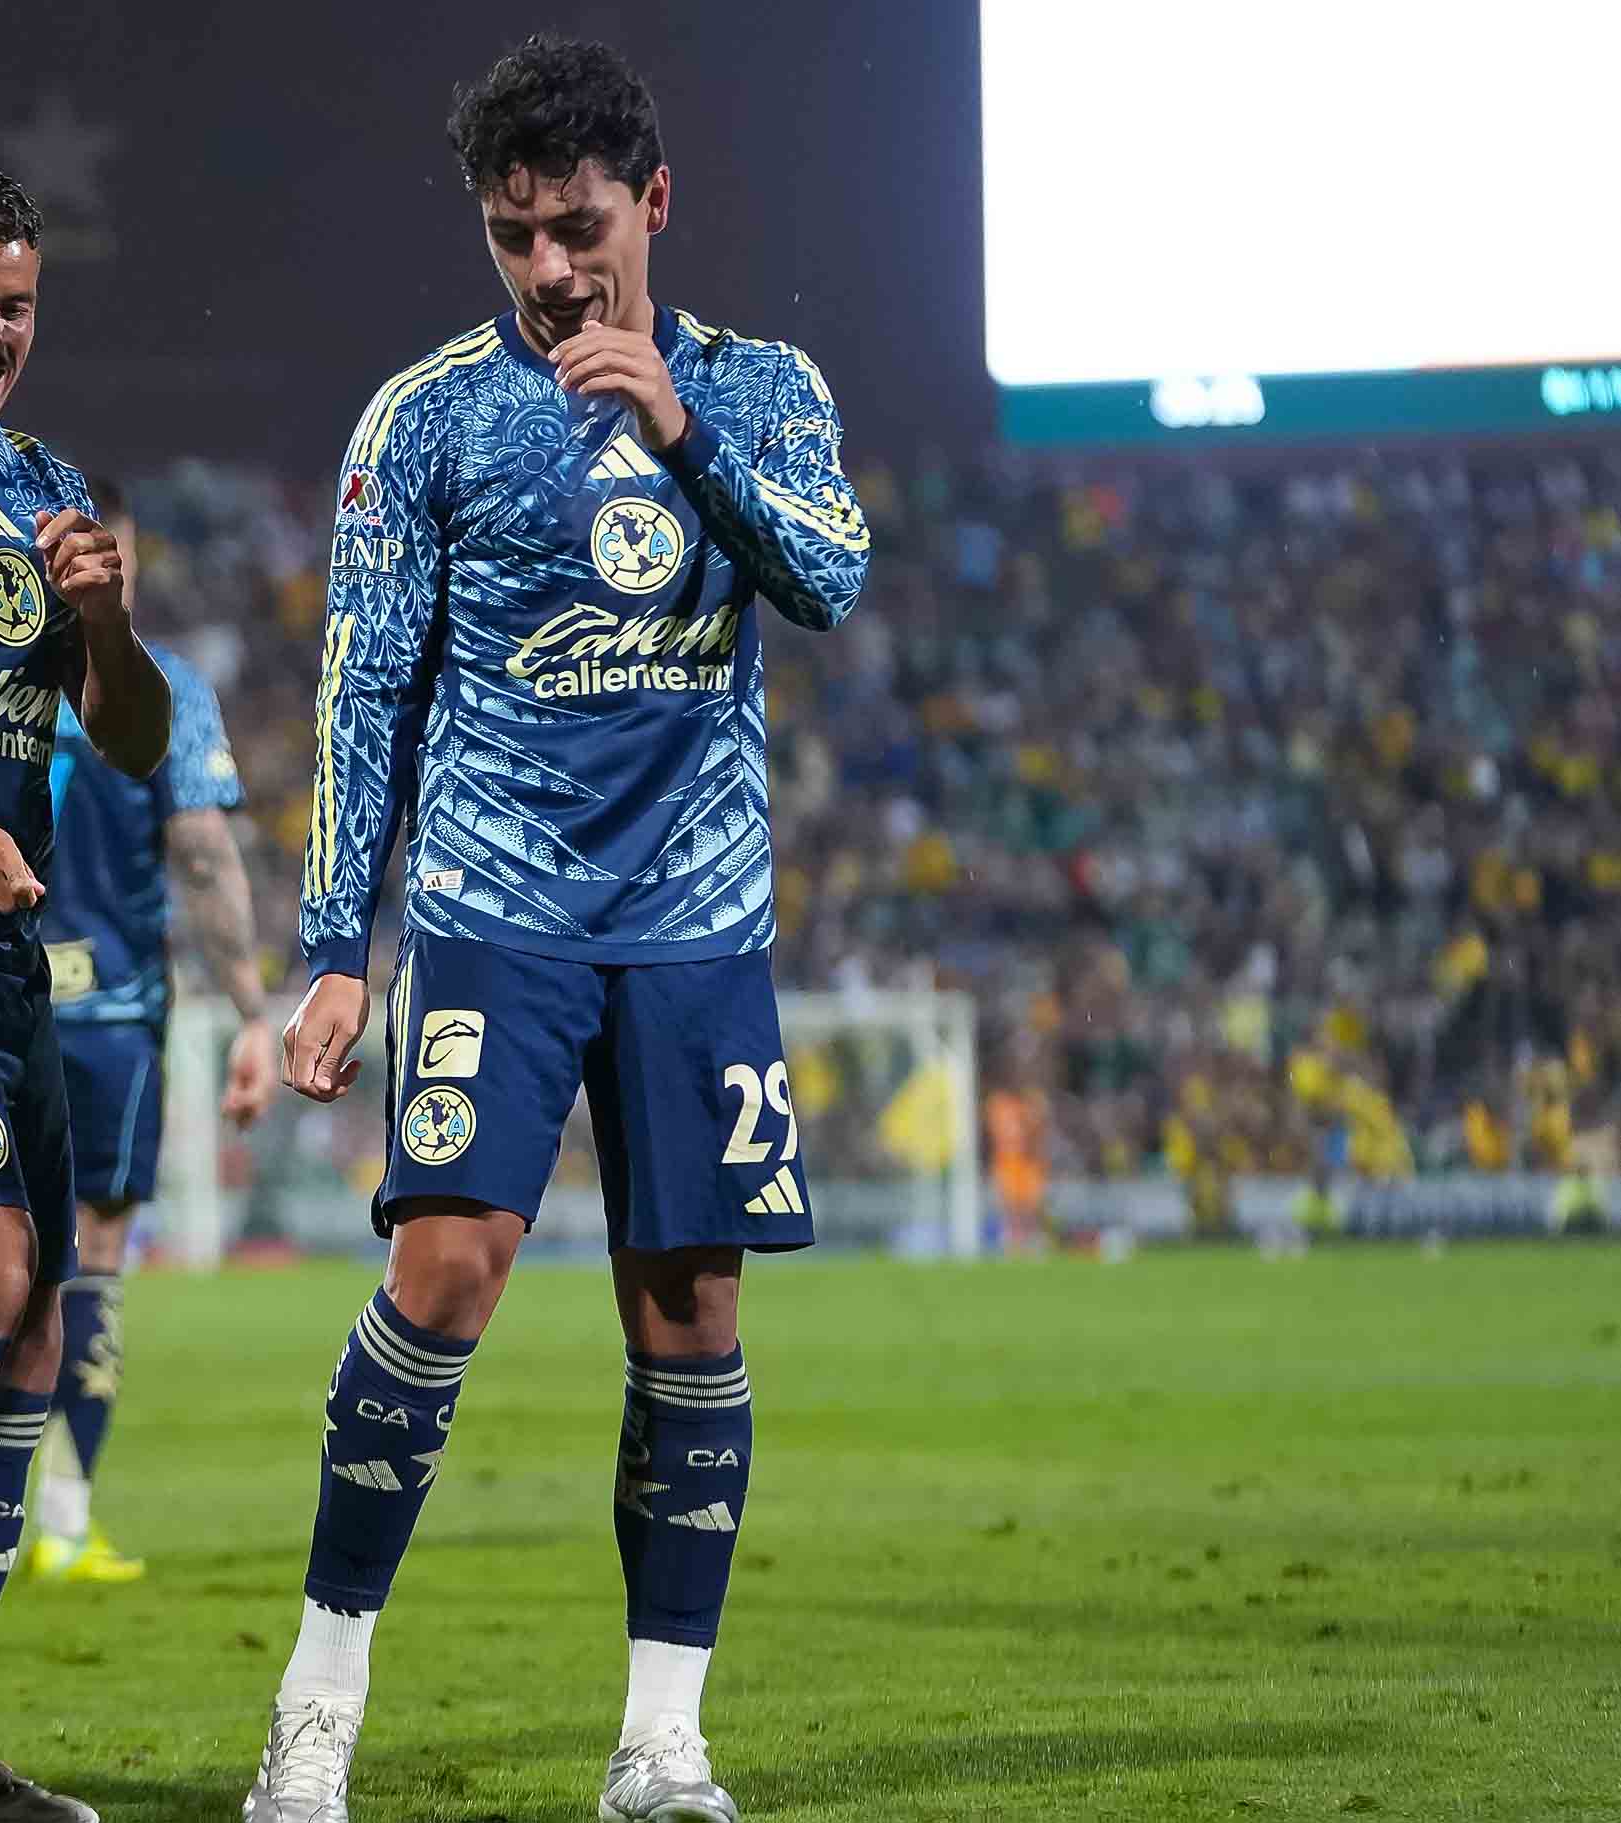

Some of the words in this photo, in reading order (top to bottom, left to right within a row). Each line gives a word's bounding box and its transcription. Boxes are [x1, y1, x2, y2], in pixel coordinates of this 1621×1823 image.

[332, 533, 405, 574] GNP
[331, 573, 405, 593] EGUROS
[721, 1060, 800, 1165] 29
[356, 1398, 409, 1431] CA
[687, 1448, 739, 1468] CA
